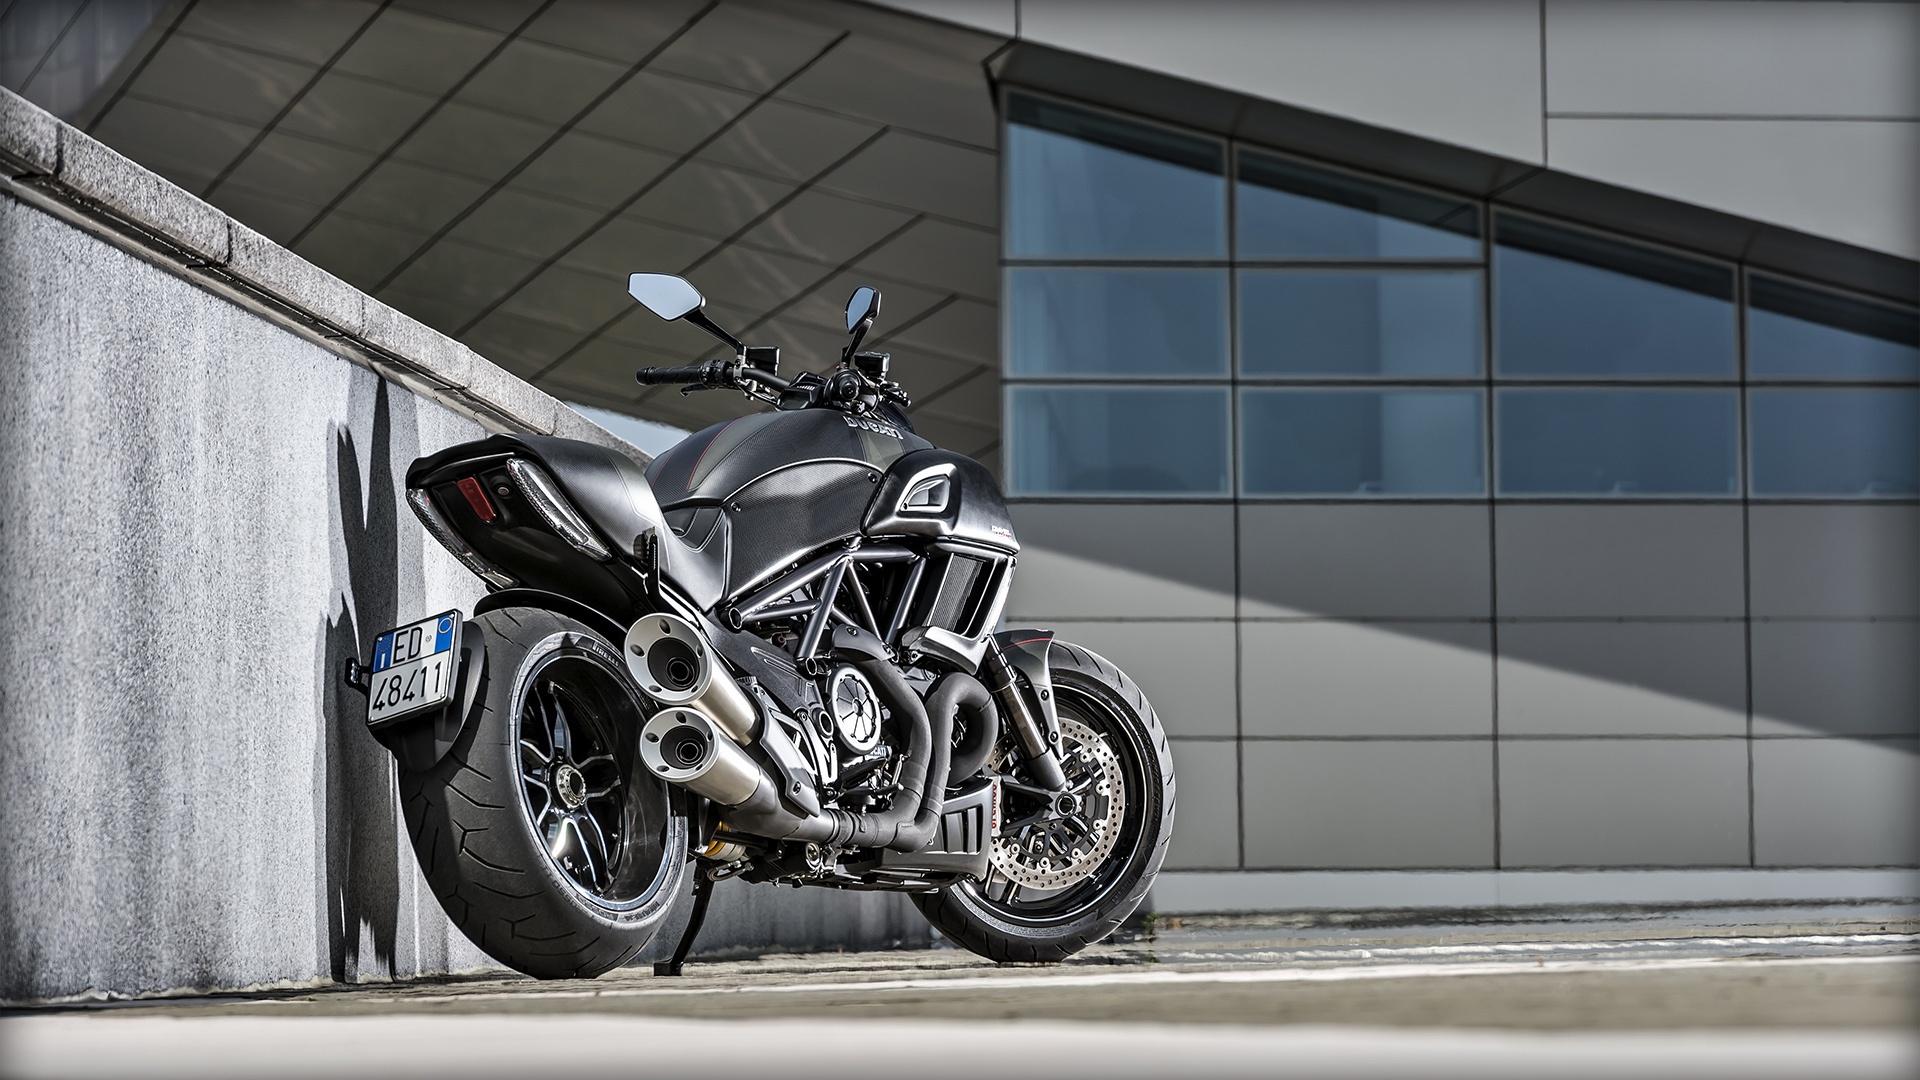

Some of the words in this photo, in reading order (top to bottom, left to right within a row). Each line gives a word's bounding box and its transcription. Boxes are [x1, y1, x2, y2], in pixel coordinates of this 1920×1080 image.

[842, 415, 904, 440] DUCATI
[393, 626, 424, 665] ED
[372, 661, 442, 711] 48411
